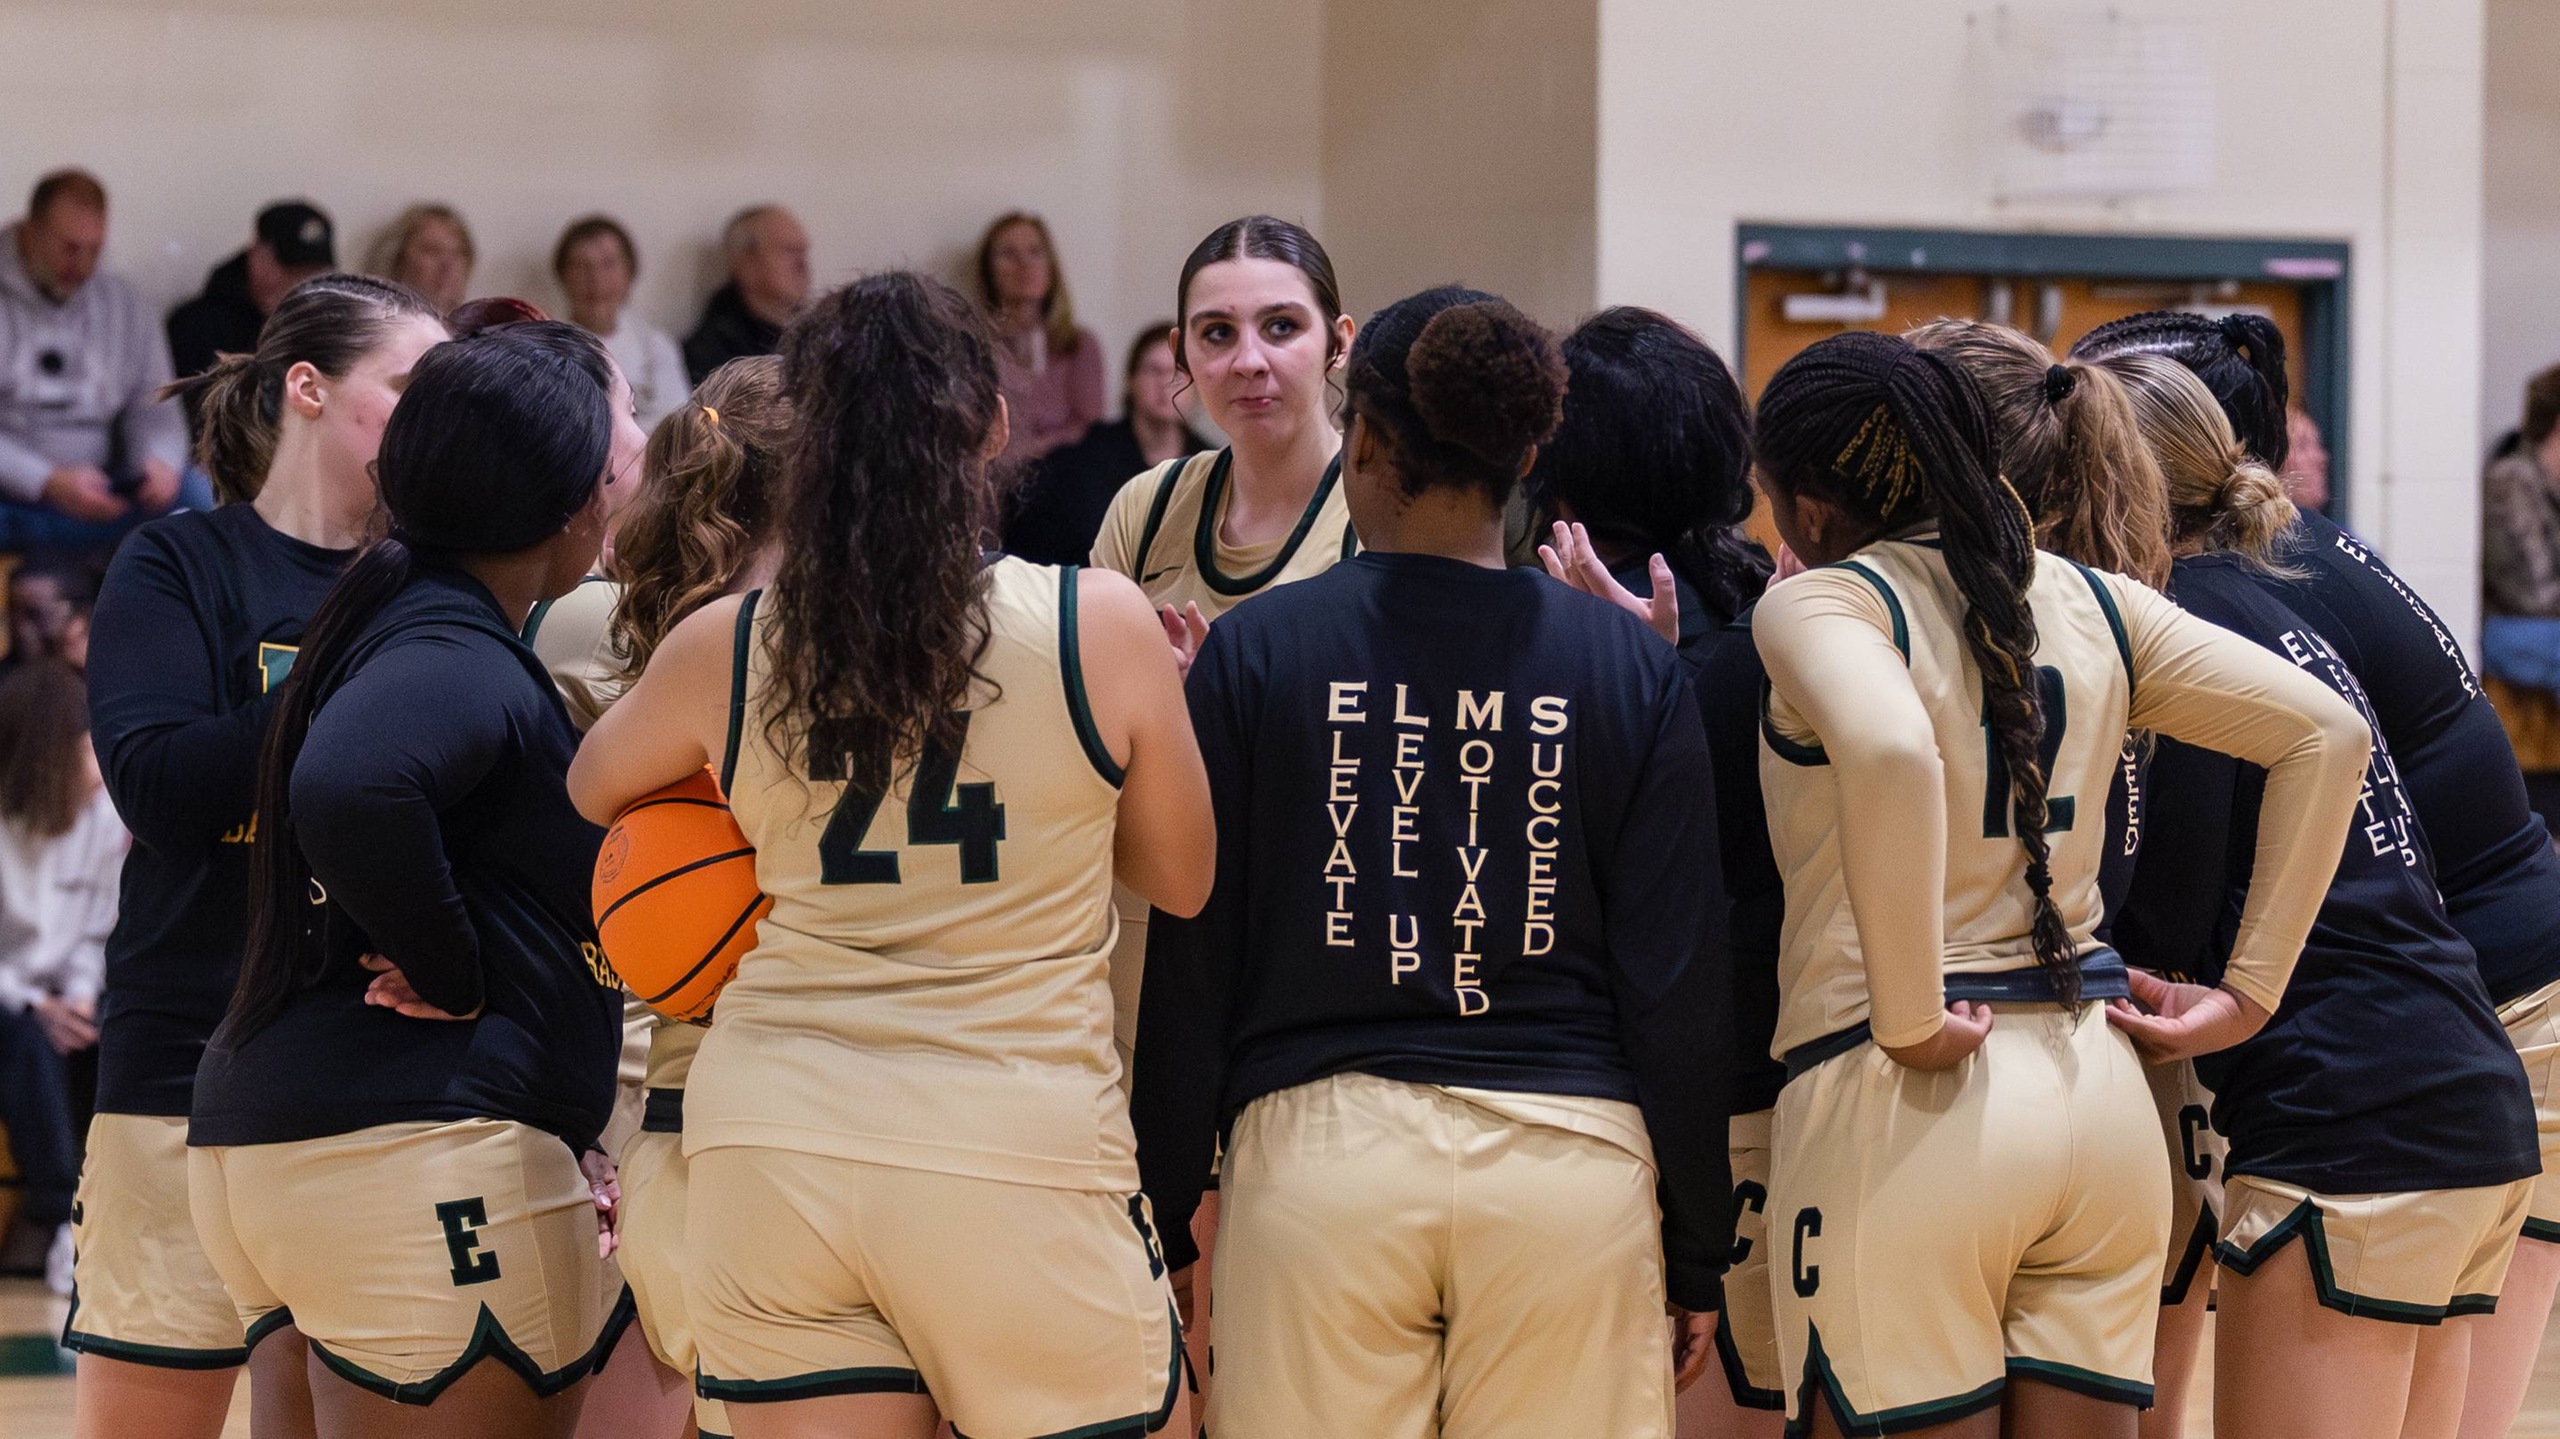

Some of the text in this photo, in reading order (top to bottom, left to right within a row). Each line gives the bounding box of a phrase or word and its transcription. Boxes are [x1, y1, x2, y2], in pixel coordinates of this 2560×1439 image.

[807, 710, 1007, 886] 24
[1323, 681, 1368, 947] ELEVATE
[1389, 683, 1430, 985] LEVEL UP
[1452, 690, 1505, 1016] MOTIVATED
[1522, 696, 1569, 956] SUCCEED
[1732, 1178, 1768, 1266] C
[2178, 1103, 2212, 1181] C
[434, 1195, 502, 1288] E
[1791, 1206, 1823, 1299] C
